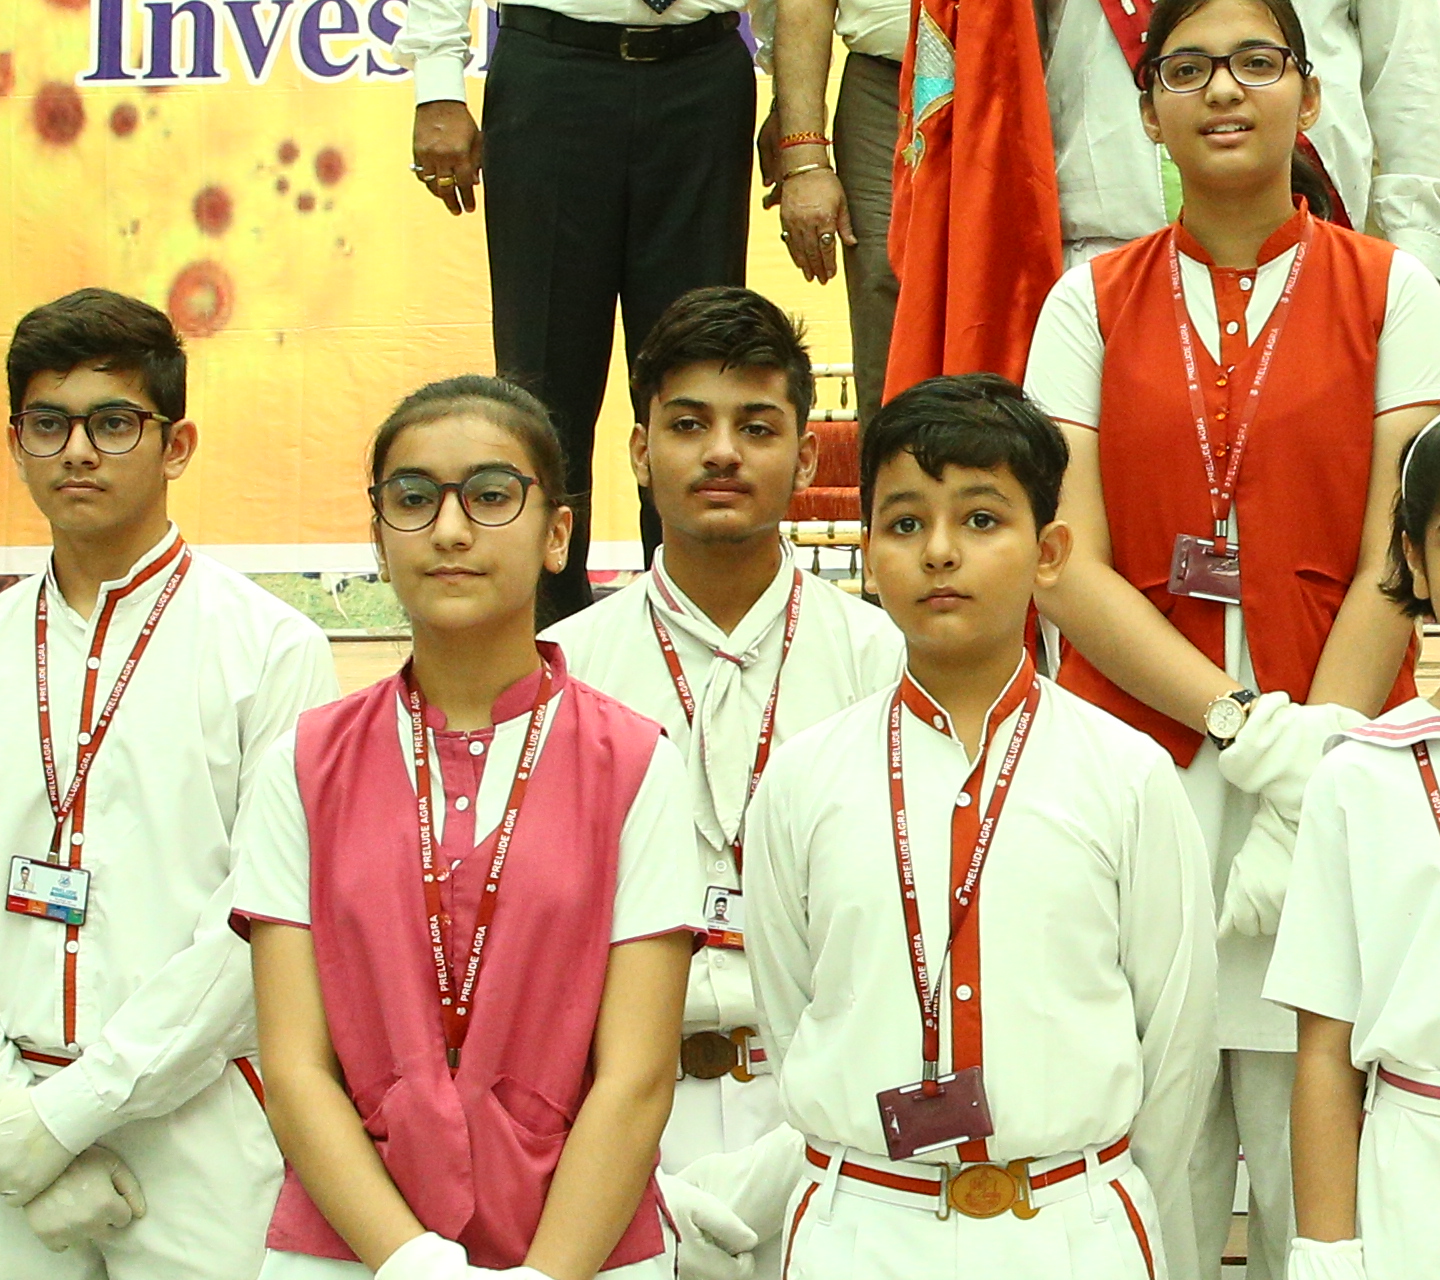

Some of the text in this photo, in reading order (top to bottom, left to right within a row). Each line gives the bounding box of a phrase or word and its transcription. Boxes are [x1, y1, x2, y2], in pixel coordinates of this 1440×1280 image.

[1253, 349, 1271, 387] PRELUDE
[147, 572, 181, 627] PRELUDE AGRA
[38, 643, 47, 702] PRELUDE AGRA
[103, 658, 137, 717] PRELUDE AGRA
[523, 704, 547, 769] PRELUDE AGRA
[1001, 710, 1031, 776] PRELUDE AGRA
[61, 751, 93, 813] PRELUDE AGRA
[419, 797, 432, 870] PRELUDE AGRA
[490, 808, 518, 880] PRELUDE AGRA
[896, 808, 914, 886] PRELUDE AGRA
[963, 815, 995, 894] PRELUDE AGRA
[430, 914, 449, 992] PRELUDE AGRA
[460, 924, 488, 1003] PRELUDE AGRA
[913, 933, 933, 1014] PRELUDE AGRA
